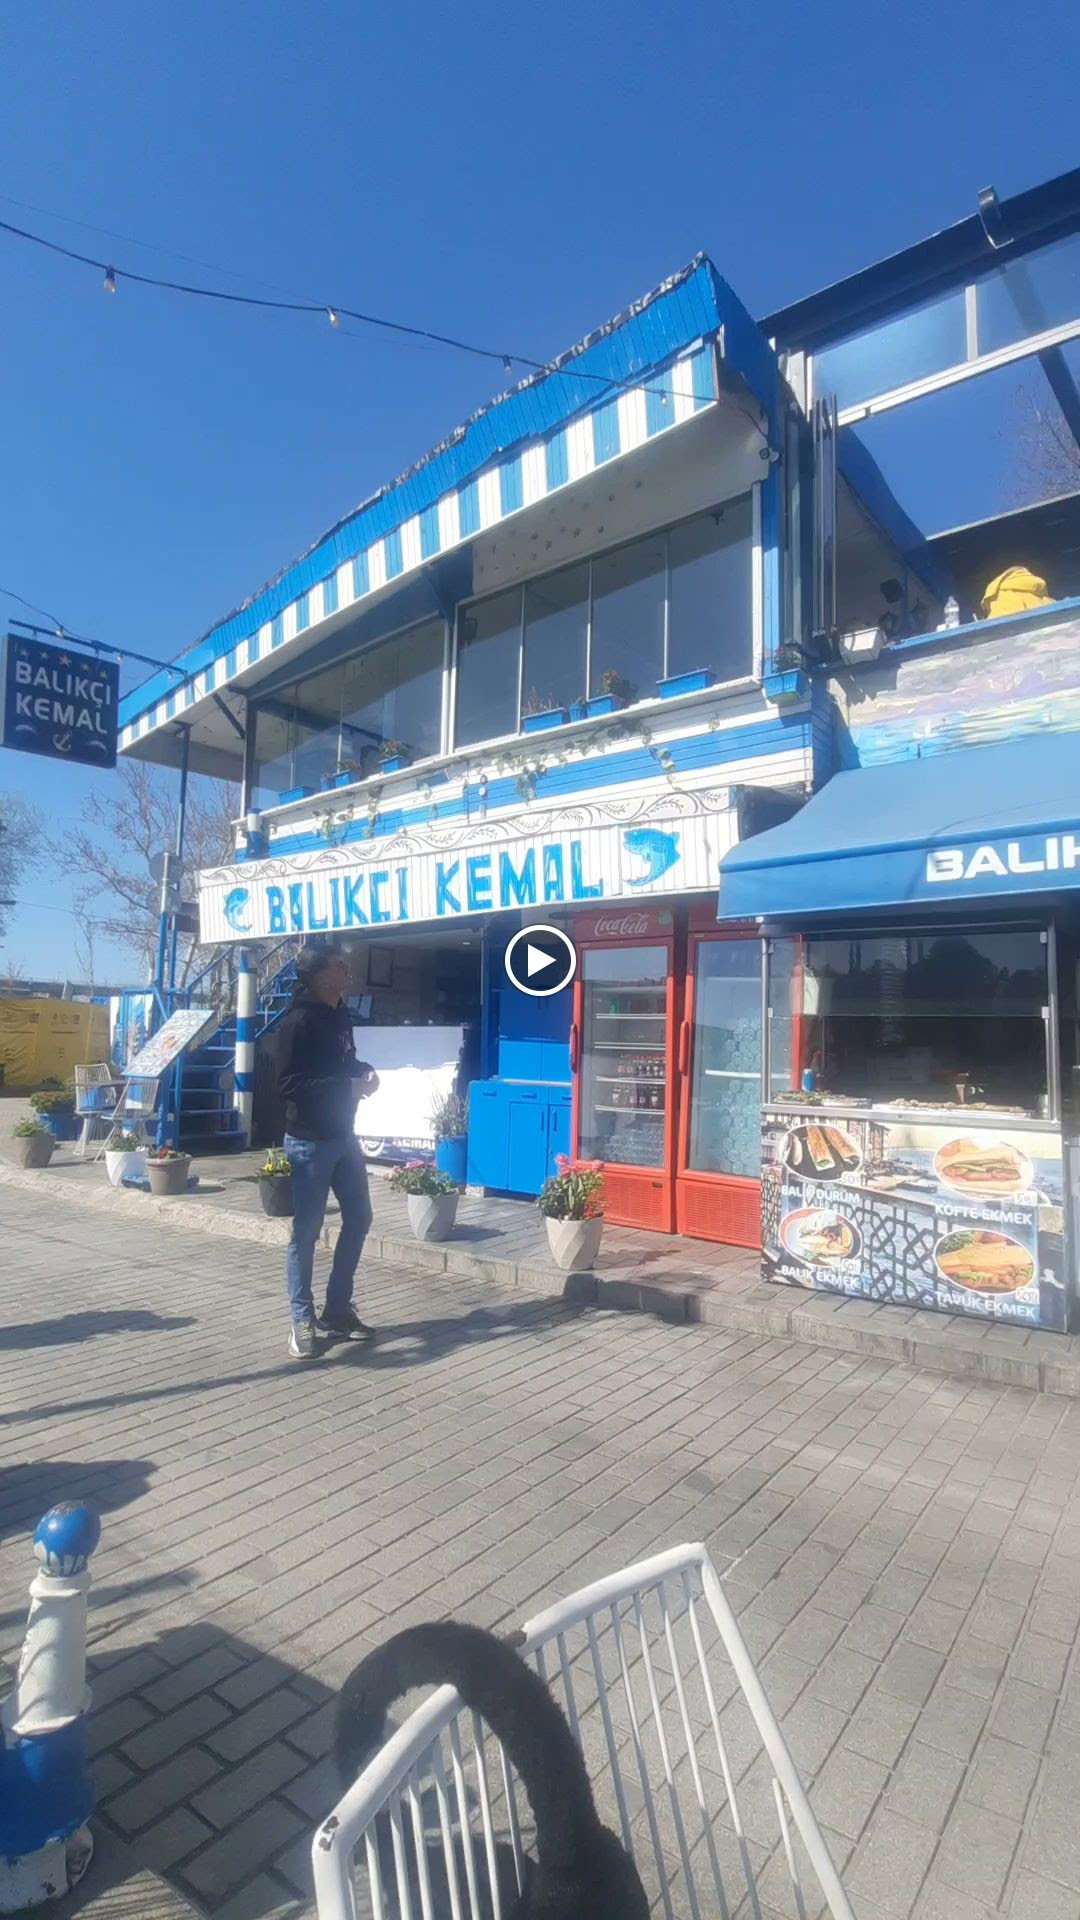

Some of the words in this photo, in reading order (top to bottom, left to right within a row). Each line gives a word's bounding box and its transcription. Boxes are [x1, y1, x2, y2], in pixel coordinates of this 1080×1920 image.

[15, 660, 112, 708] BALIKÇI
[15, 692, 108, 735] KEMAL
[436, 840, 604, 916] KEMAL
